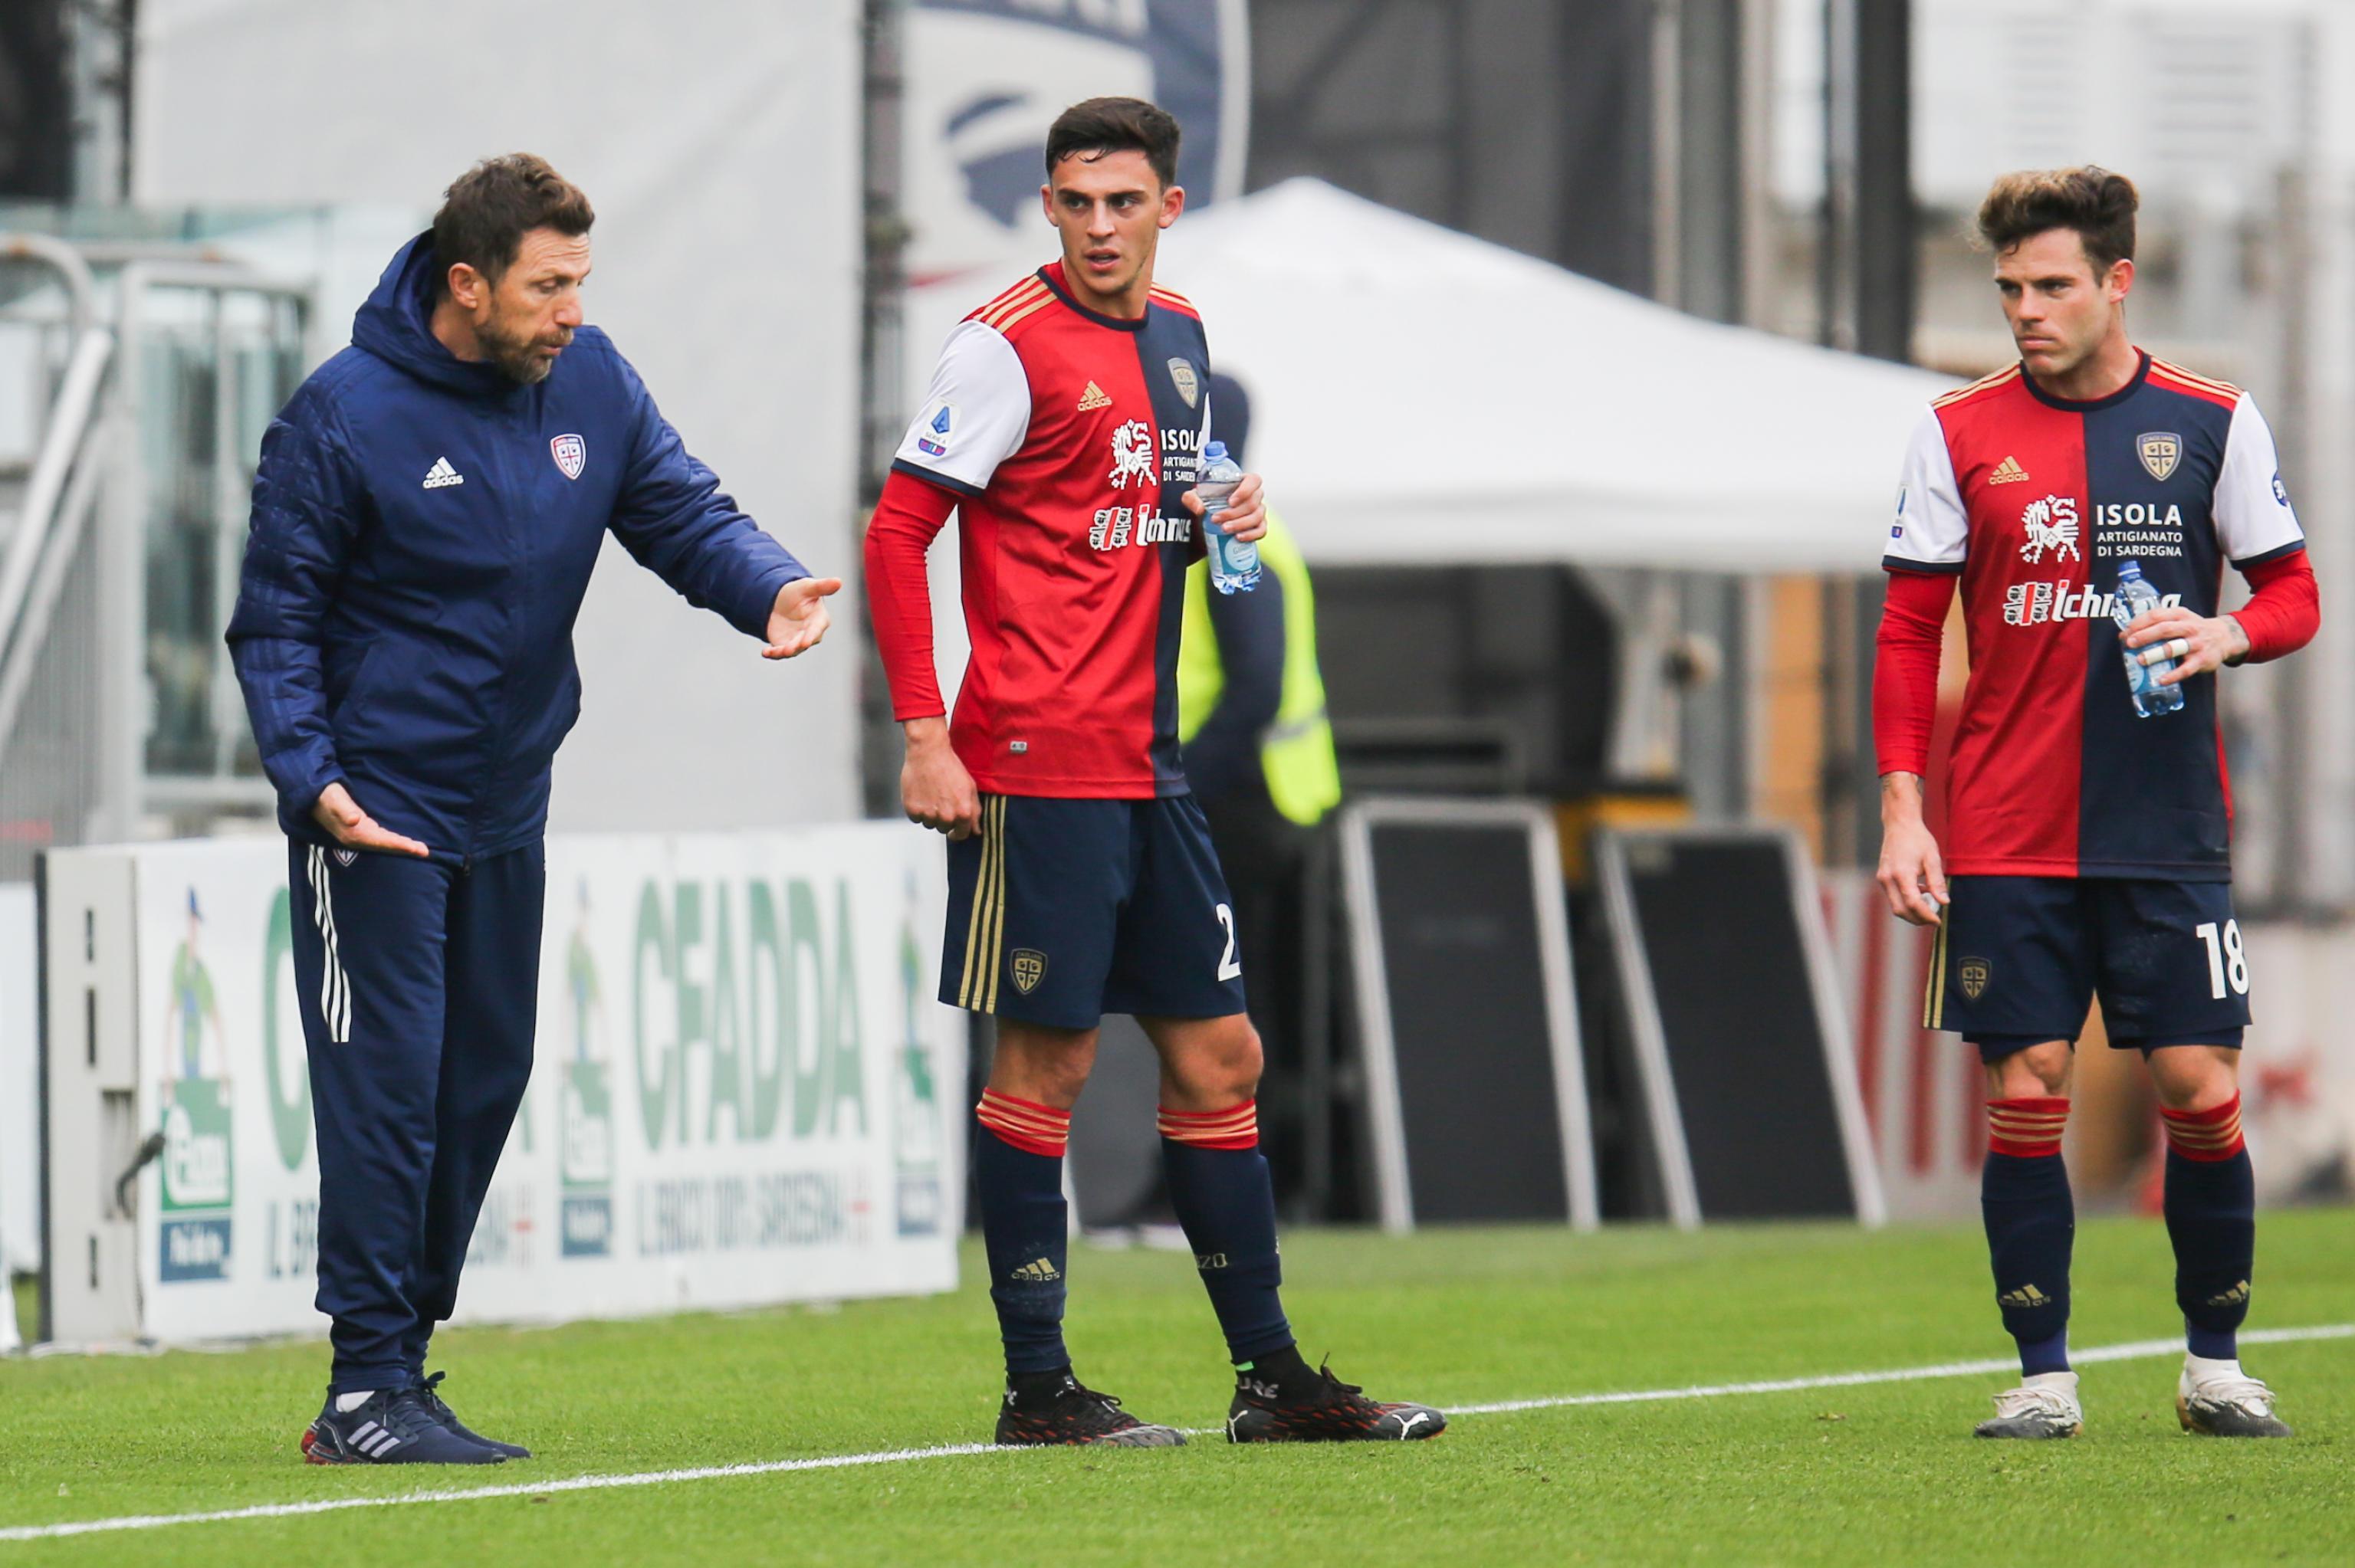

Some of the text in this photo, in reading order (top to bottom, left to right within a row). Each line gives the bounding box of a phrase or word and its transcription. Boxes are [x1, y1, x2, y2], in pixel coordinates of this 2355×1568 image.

[1077, 396, 1112, 411] adidas
[422, 474, 464, 489] adidas
[1163, 471, 1172, 481] DI
[1989, 472, 2030, 485] adidas
[2097, 504, 2183, 526] ISOLA
[2097, 531, 2183, 543] ARTIGIANATO
[2097, 546, 2183, 556] DI SARDEGNA
[2196, 919, 2249, 999] 18
[632, 877, 868, 1152] CFADDA
[1011, 1271, 1060, 1281] adidas
